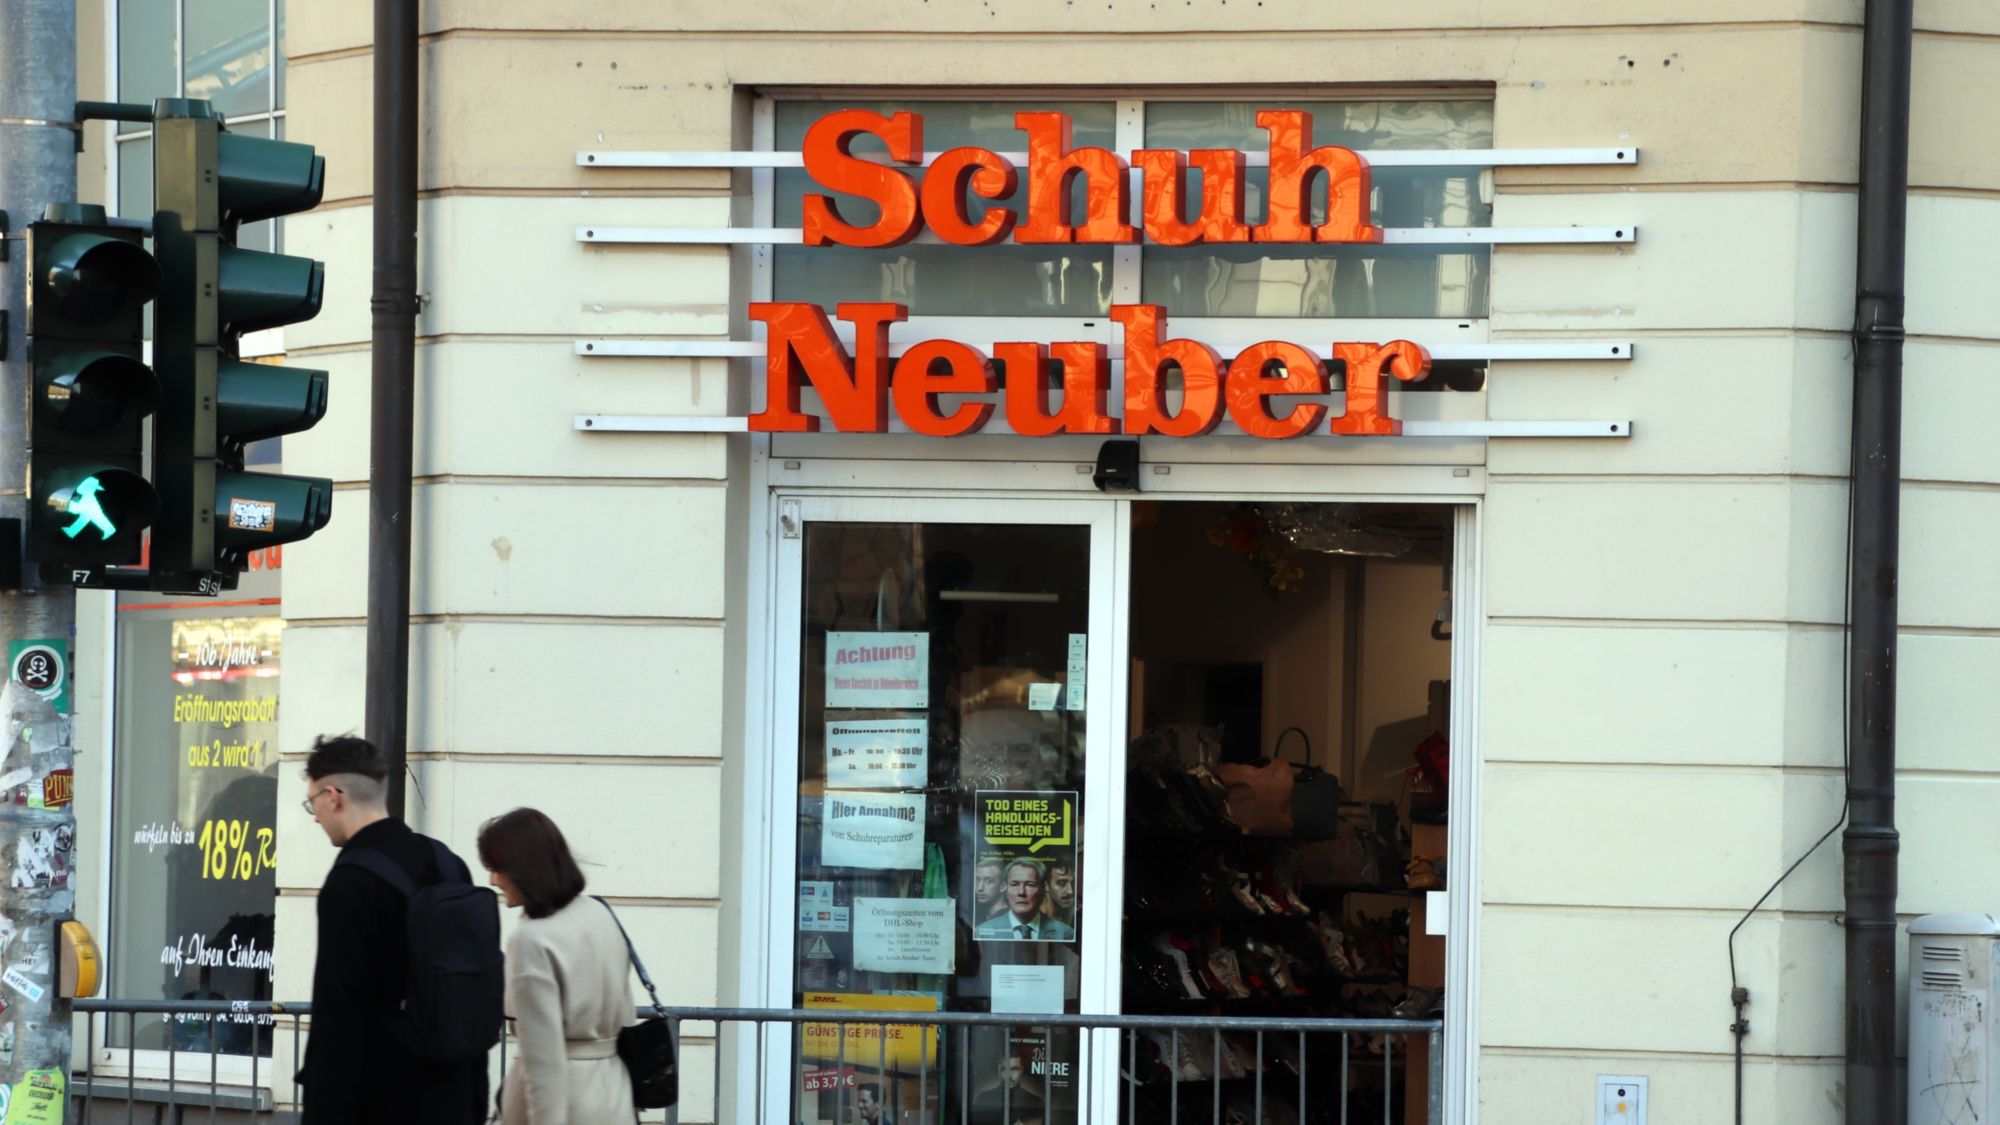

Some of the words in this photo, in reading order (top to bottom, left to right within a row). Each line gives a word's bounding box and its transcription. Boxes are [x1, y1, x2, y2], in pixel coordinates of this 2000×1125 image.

[802, 108, 1383, 248] Schuh
[748, 302, 1431, 439] Neuber
[73, 570, 91, 583] F7
[195, 641, 217, 666] 106
[219, 633, 257, 673] Jahre
[836, 645, 916, 665] Achtung
[174, 694, 277, 728] Eröffnungsrabatt
[188, 745, 210, 767] aus
[212, 740, 221, 767] 2
[223, 740, 250, 767] wird
[251, 739, 260, 767] 1
[832, 801, 857, 819] Hier
[859, 806, 916, 822] Annahme
[985, 799, 1010, 811] TOD
[1014, 799, 1048, 811] EINES
[985, 812, 1061, 824] HANDLUNGS-
[831, 829, 845, 840] von
[847, 831, 914, 845] Schuhreparaturen
[985, 825, 1051, 836] REISENDEN
[170, 821, 182, 844] bis
[199, 820, 252, 881] 18%
[872, 907, 926, 917] Öffnungszeiten
[884, 919, 924, 928] DHL-Shop
[161, 936, 183, 978] auf
[185, 933, 223, 967] Ihren
[227, 934, 274, 983] Einkauf
[806, 1078, 820, 1089] ab
